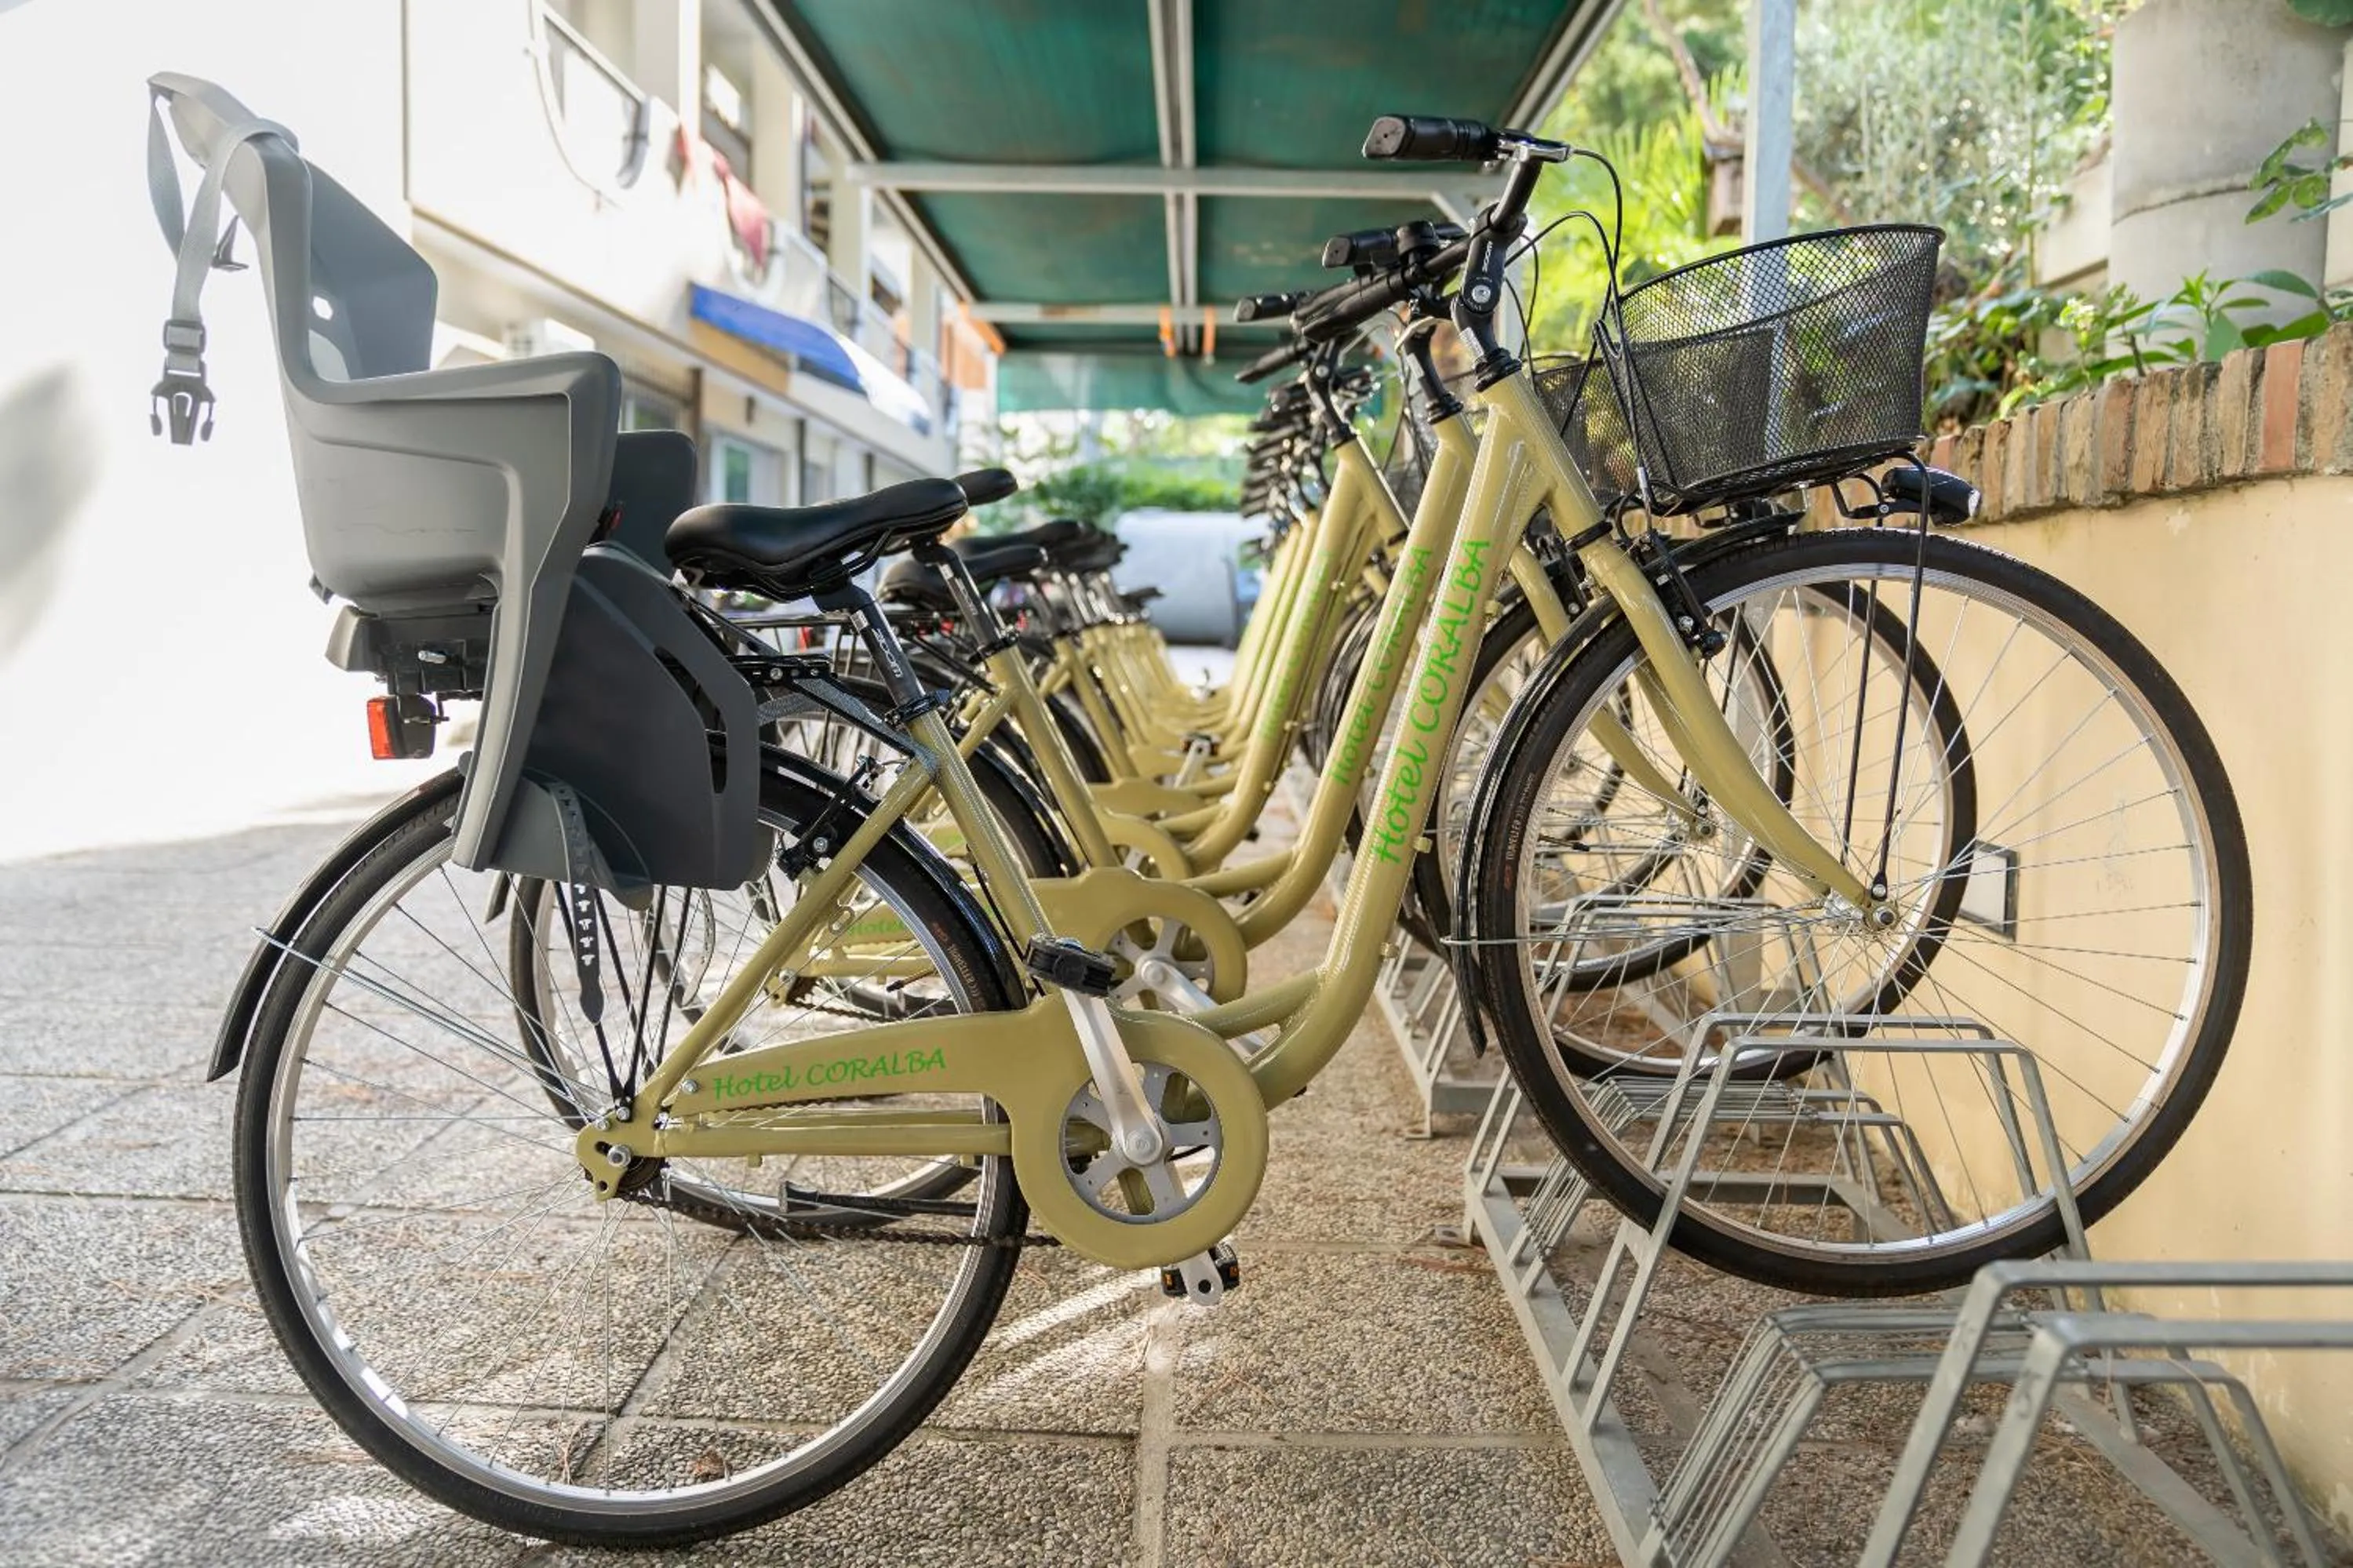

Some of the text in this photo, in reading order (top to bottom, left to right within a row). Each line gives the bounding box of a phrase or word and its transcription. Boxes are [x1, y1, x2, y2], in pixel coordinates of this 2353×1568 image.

[1372, 540, 1490, 863] Hotel CORALBA
[713, 1048, 947, 1099] Hotel CORALBA
